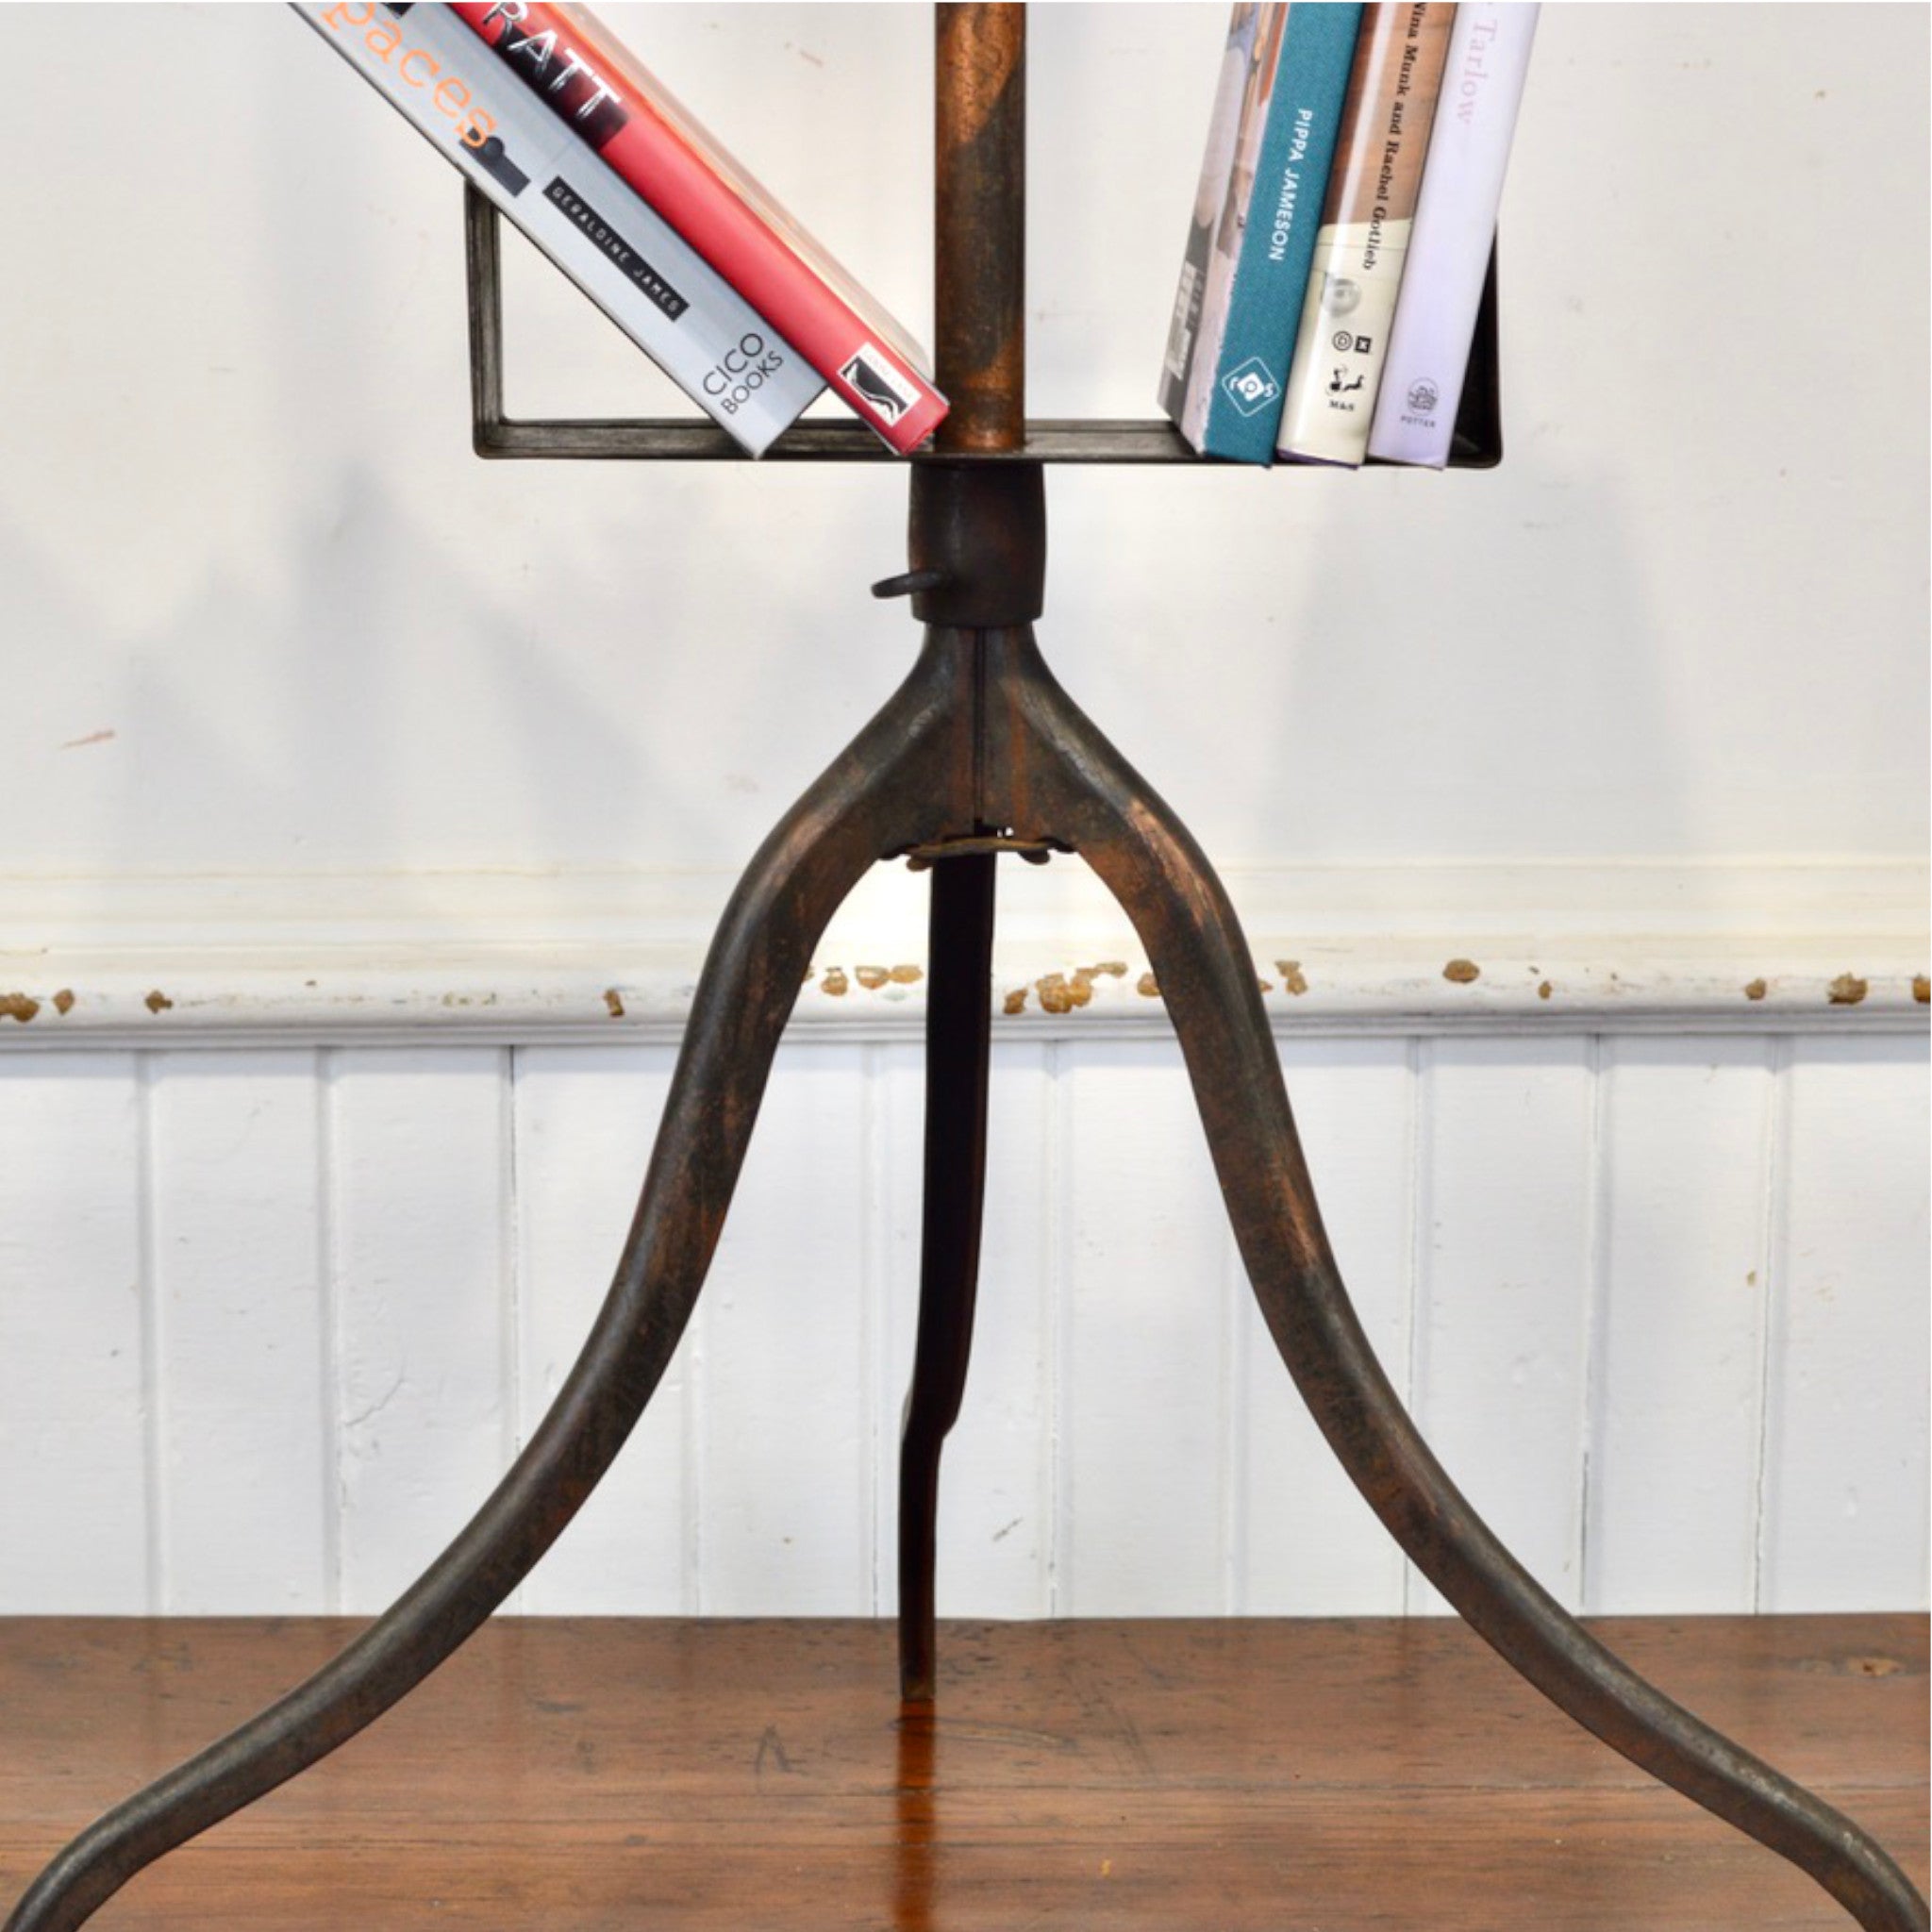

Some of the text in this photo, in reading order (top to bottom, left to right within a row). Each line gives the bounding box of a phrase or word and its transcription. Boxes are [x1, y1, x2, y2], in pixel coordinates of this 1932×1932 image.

[1397, 44, 1419, 96] Munk
[1457, 19, 1497, 125] Tarlow
[1389, 101, 1405, 135] and
[1268, 108, 1313, 261] PIPPA JAMESON
[1377, 141, 1400, 201] Rachel
[552, 187, 680, 312] GERALDINE JAMES
[1363, 207, 1387, 271] Gotlieb
[703, 333, 764, 394] CICO
[721, 350, 784, 414] BOOKS
